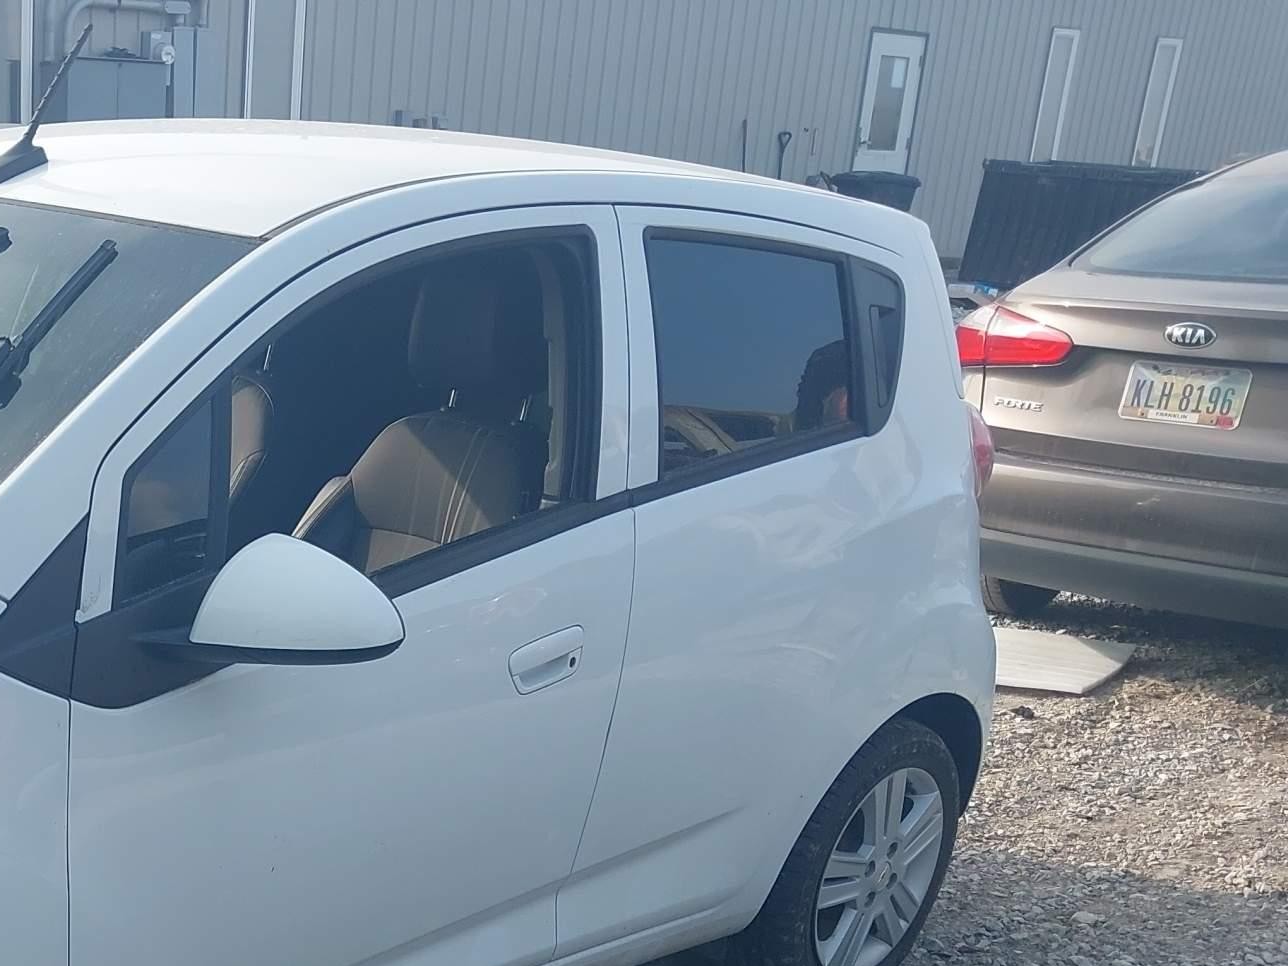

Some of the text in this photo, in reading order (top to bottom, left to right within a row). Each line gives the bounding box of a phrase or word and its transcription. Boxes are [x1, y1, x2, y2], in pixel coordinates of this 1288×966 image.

[1171, 326, 1206, 345] KIA
[1131, 378, 1236, 416] KLH 8196
